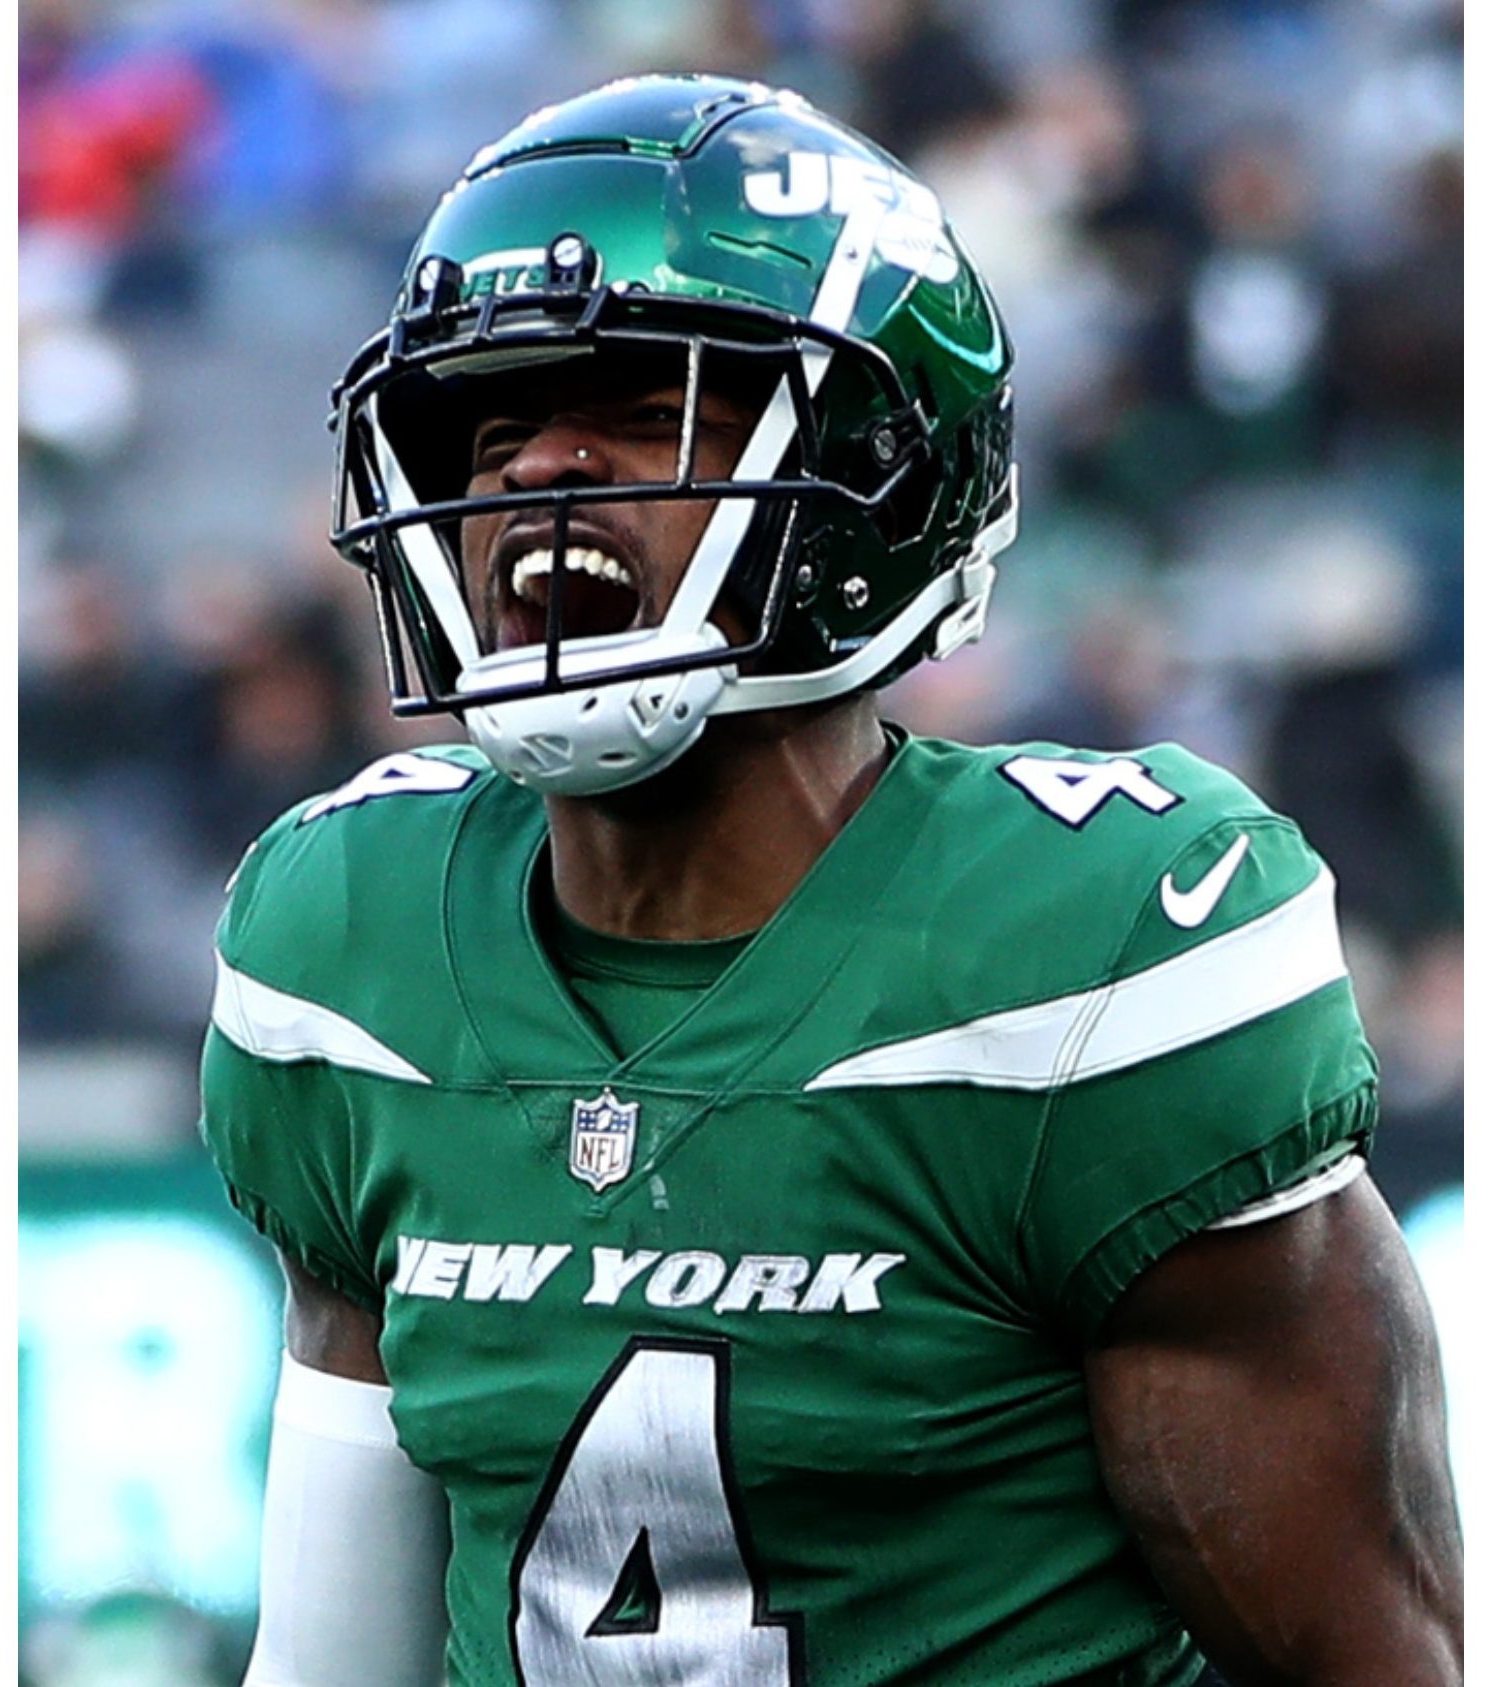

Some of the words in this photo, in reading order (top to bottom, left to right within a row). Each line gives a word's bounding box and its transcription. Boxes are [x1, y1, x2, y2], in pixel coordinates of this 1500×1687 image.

[996, 755, 1185, 831] 4
[579, 1136, 620, 1172] NFL
[582, 1246, 906, 1315] YORK
[508, 1334, 805, 1687] 4
